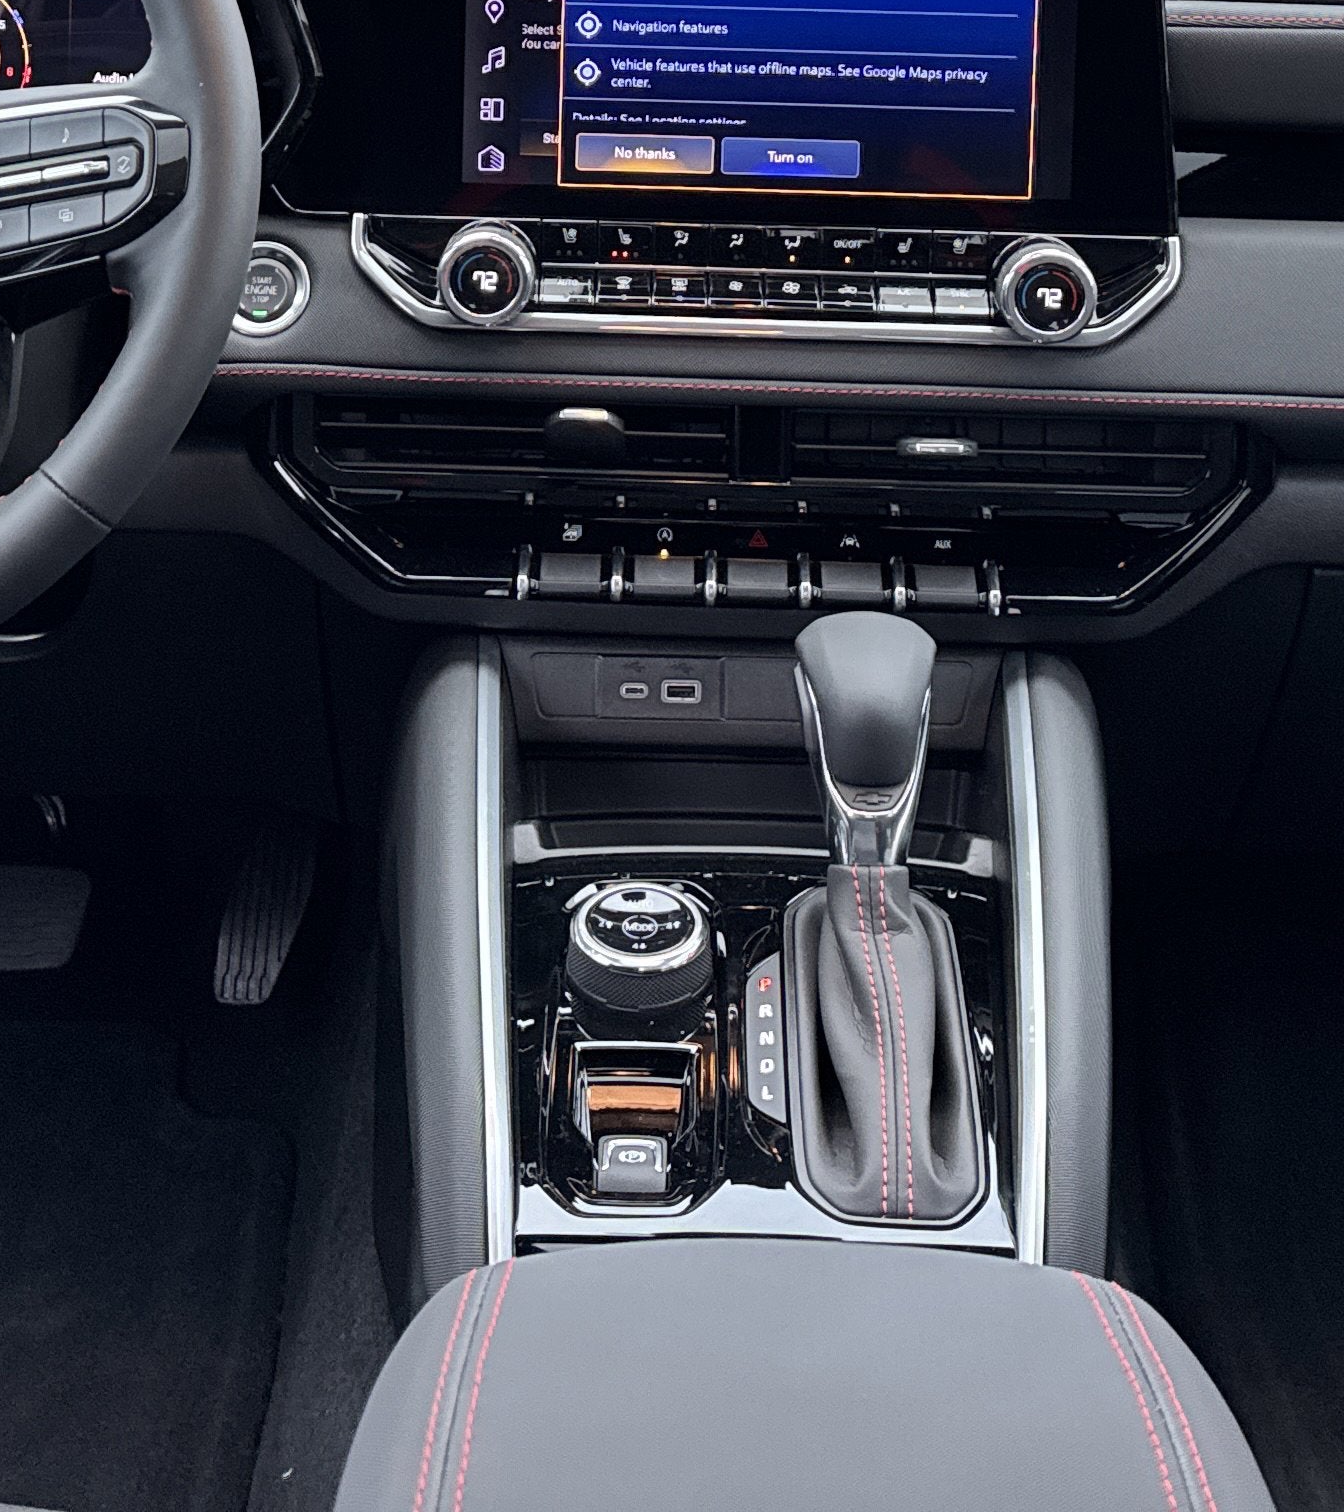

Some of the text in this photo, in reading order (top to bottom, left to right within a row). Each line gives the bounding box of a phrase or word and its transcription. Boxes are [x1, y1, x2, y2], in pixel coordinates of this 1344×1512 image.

[612, 19, 729, 36] Navigation features
[5, 66, 14, 77] 6
[610, 58, 989, 84] Vehicle features that use offline maps. See Google Maps privacy
[610, 76, 652, 89] center.
[614, 145, 676, 161] No thanks
[767, 150, 813, 164] Turn on
[833, 240, 863, 249] ON/OFF
[251, 276, 273, 284] START
[472, 270, 498, 292] 72
[244, 284, 279, 295] ENGINE
[251, 295, 270, 303] STOP
[1036, 287, 1063, 309] 72
[934, 539, 952, 549] AUX
[624, 921, 655, 932] MODE
[758, 976, 772, 992] P
[758, 1003, 773, 1018] R
[759, 1030, 775, 1046] N
[759, 1058, 775, 1074] D
[761, 1085, 774, 1101] L
